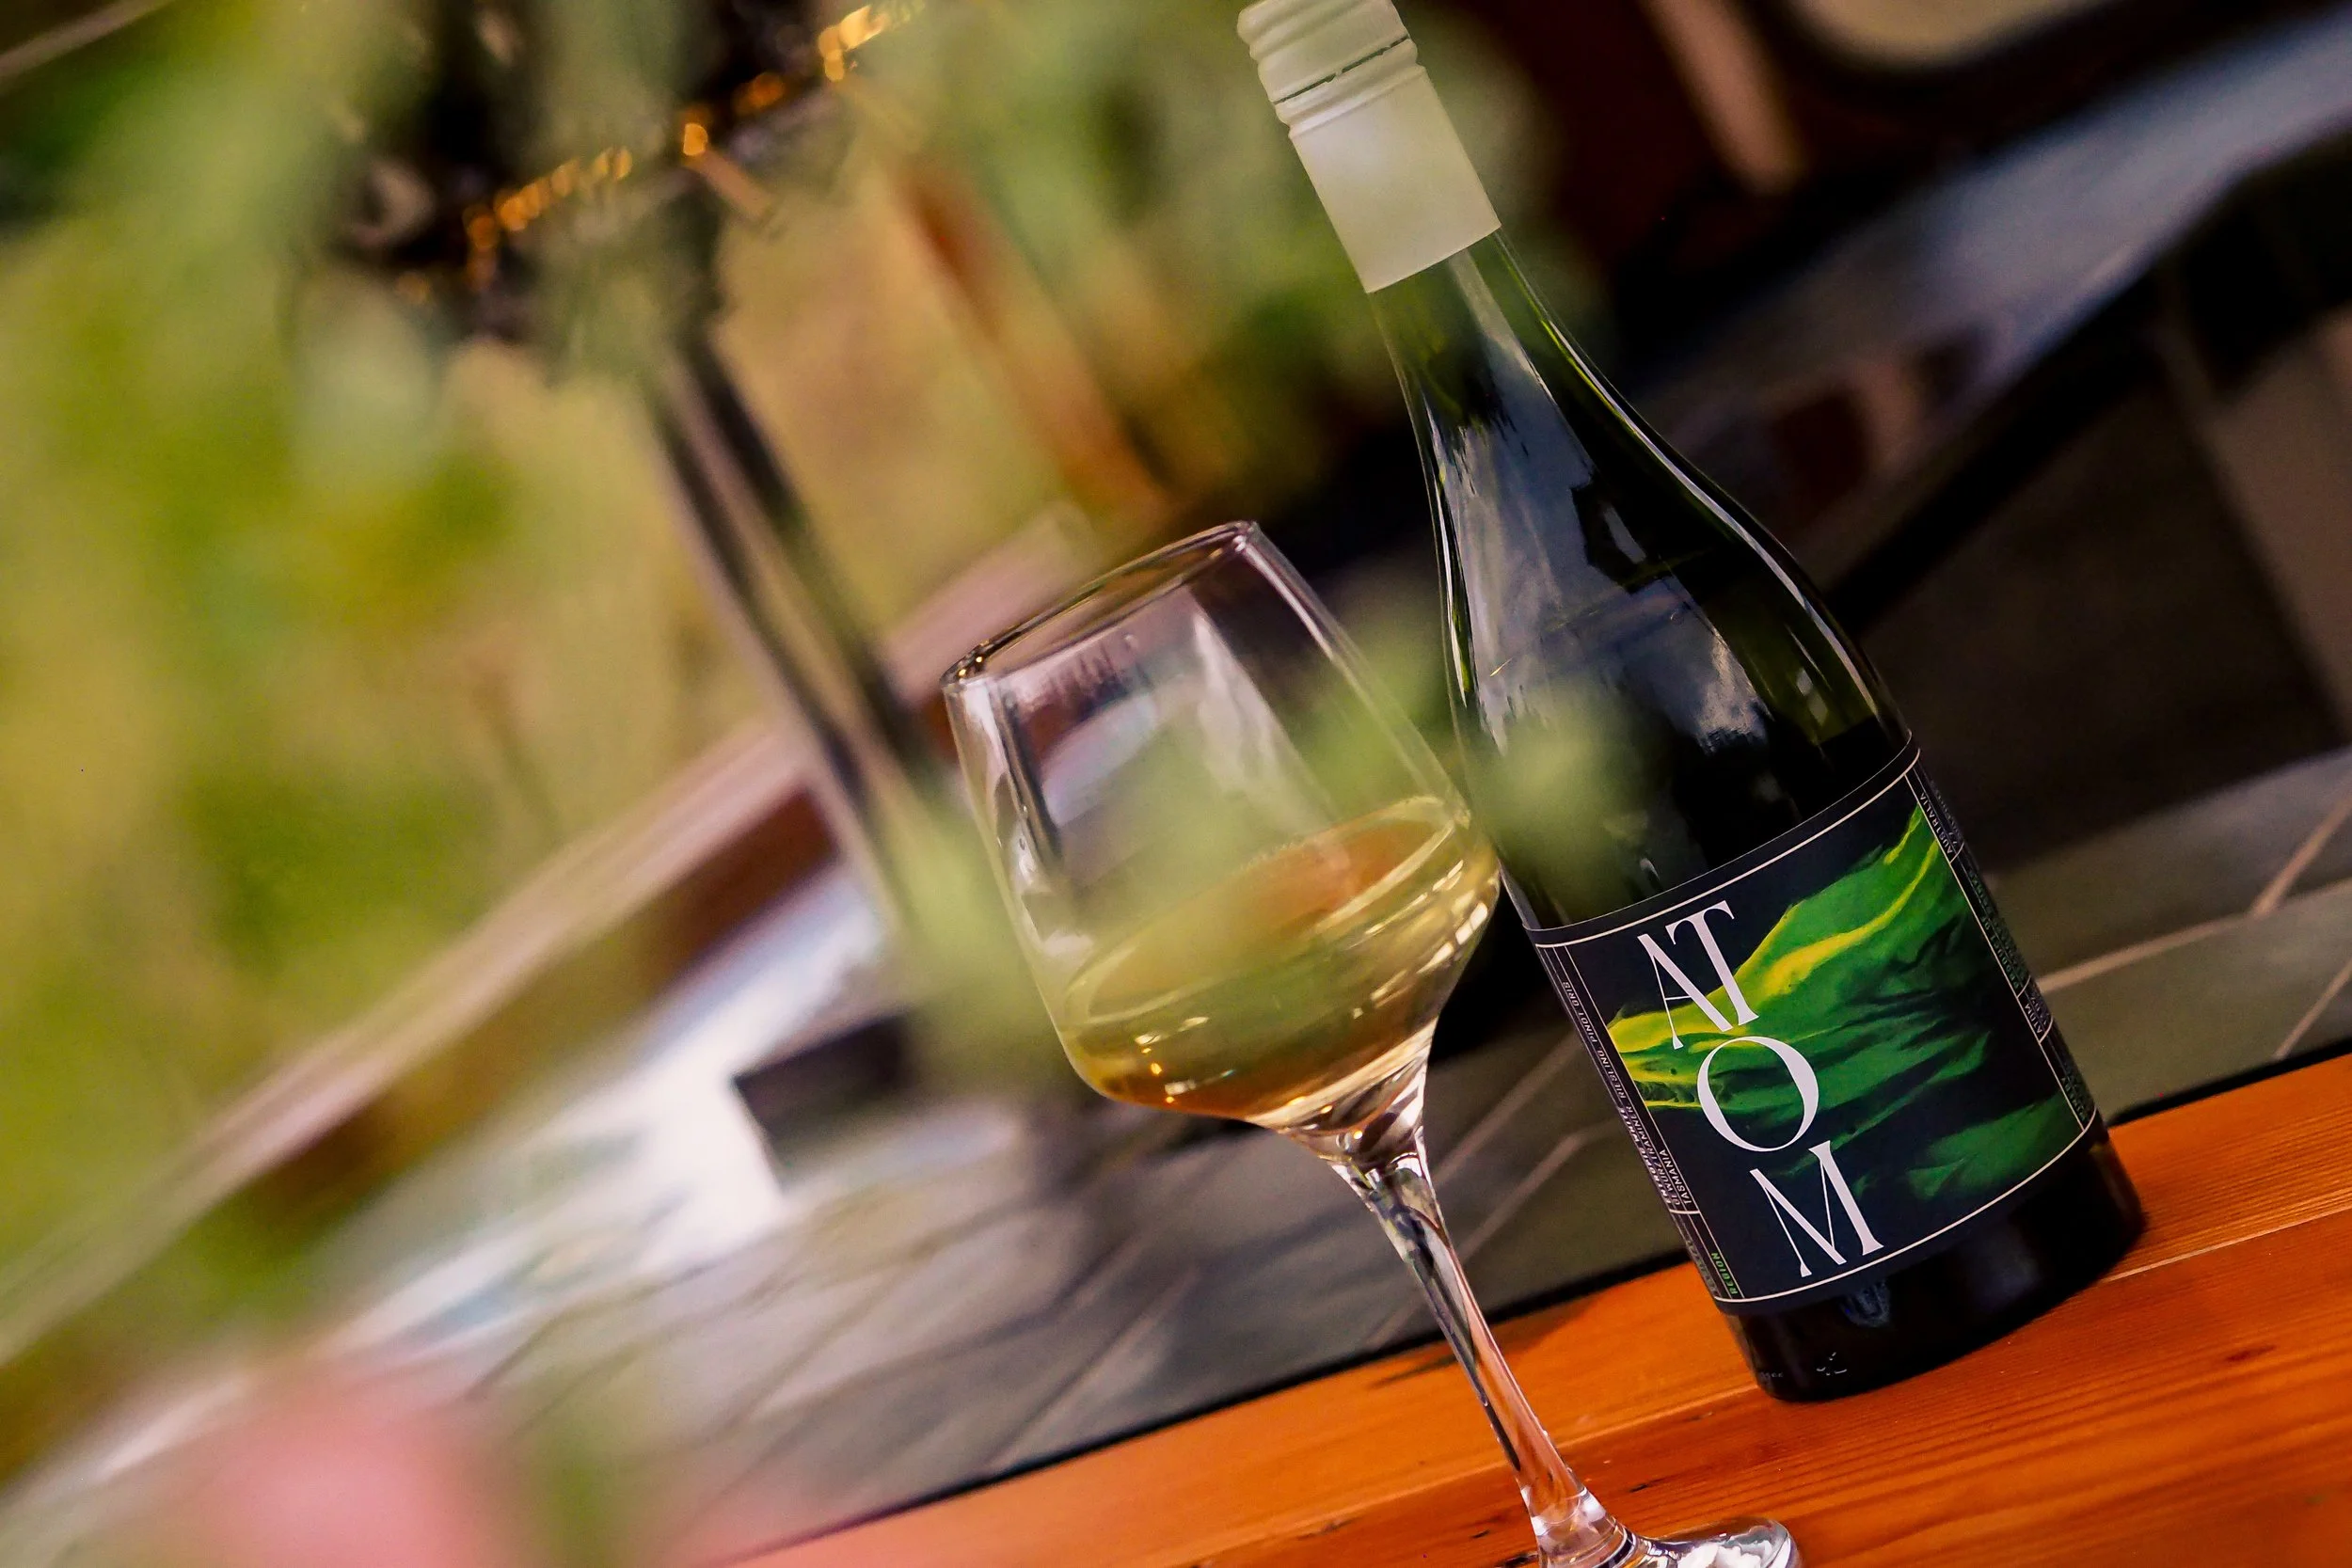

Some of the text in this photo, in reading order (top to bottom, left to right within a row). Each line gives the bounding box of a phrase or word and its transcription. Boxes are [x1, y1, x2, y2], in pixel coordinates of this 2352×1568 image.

[1919, 791, 1953, 852] AUSTRALIA
[1562, 980, 1580, 1005] GRIS
[1577, 1012, 1597, 1040] PINOT
[2025, 1002, 2043, 1032] ATOM
[1660, 1148, 1692, 1204] TASMANIA
[1710, 1252, 1738, 1293] REGION
